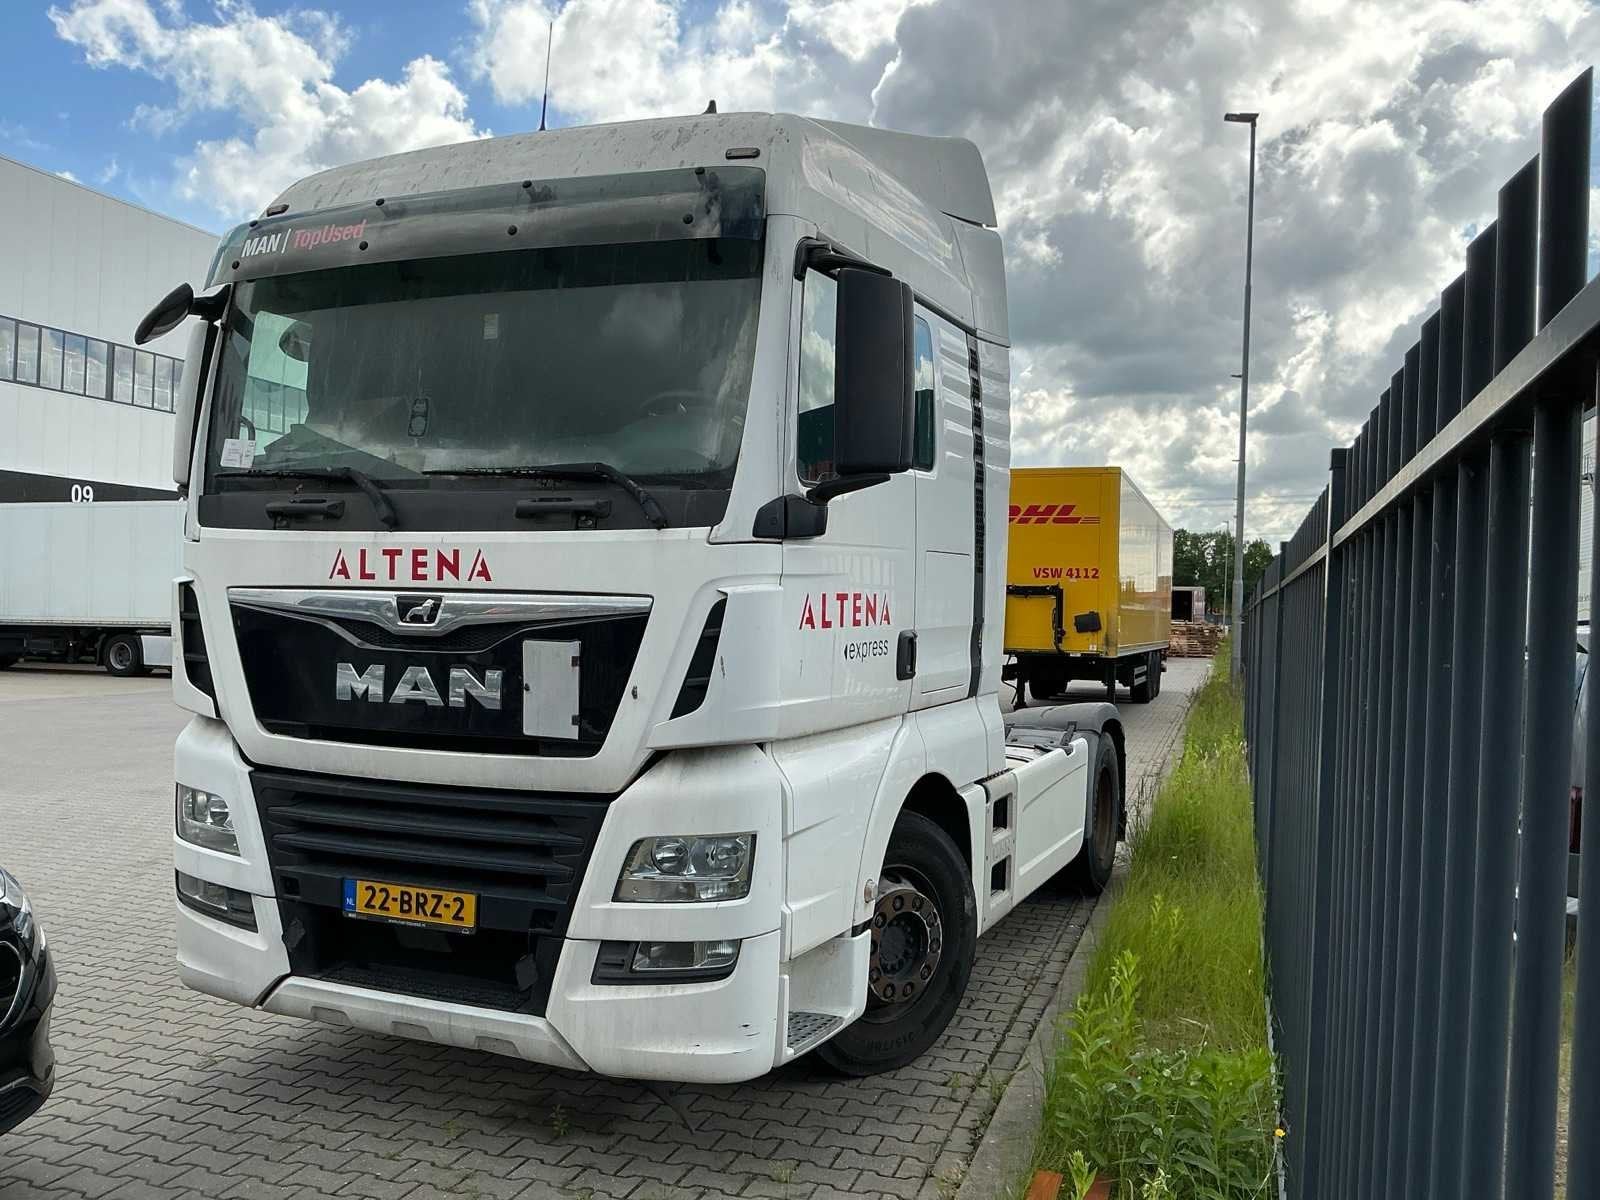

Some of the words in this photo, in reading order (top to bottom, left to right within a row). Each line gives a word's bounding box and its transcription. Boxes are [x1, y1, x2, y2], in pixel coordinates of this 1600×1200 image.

[241, 233, 281, 257] MAN
[294, 219, 367, 250] TopUsed
[71, 484, 93, 503] 09
[329, 548, 492, 581] ALTENA
[1033, 568, 1063, 578] VSW
[1066, 568, 1099, 578] 4112
[799, 593, 891, 629] ALTENA
[848, 639, 889, 662] express
[336, 663, 503, 710] MAN
[346, 897, 355, 905] NL
[364, 885, 465, 921] 22-BRZ-2
